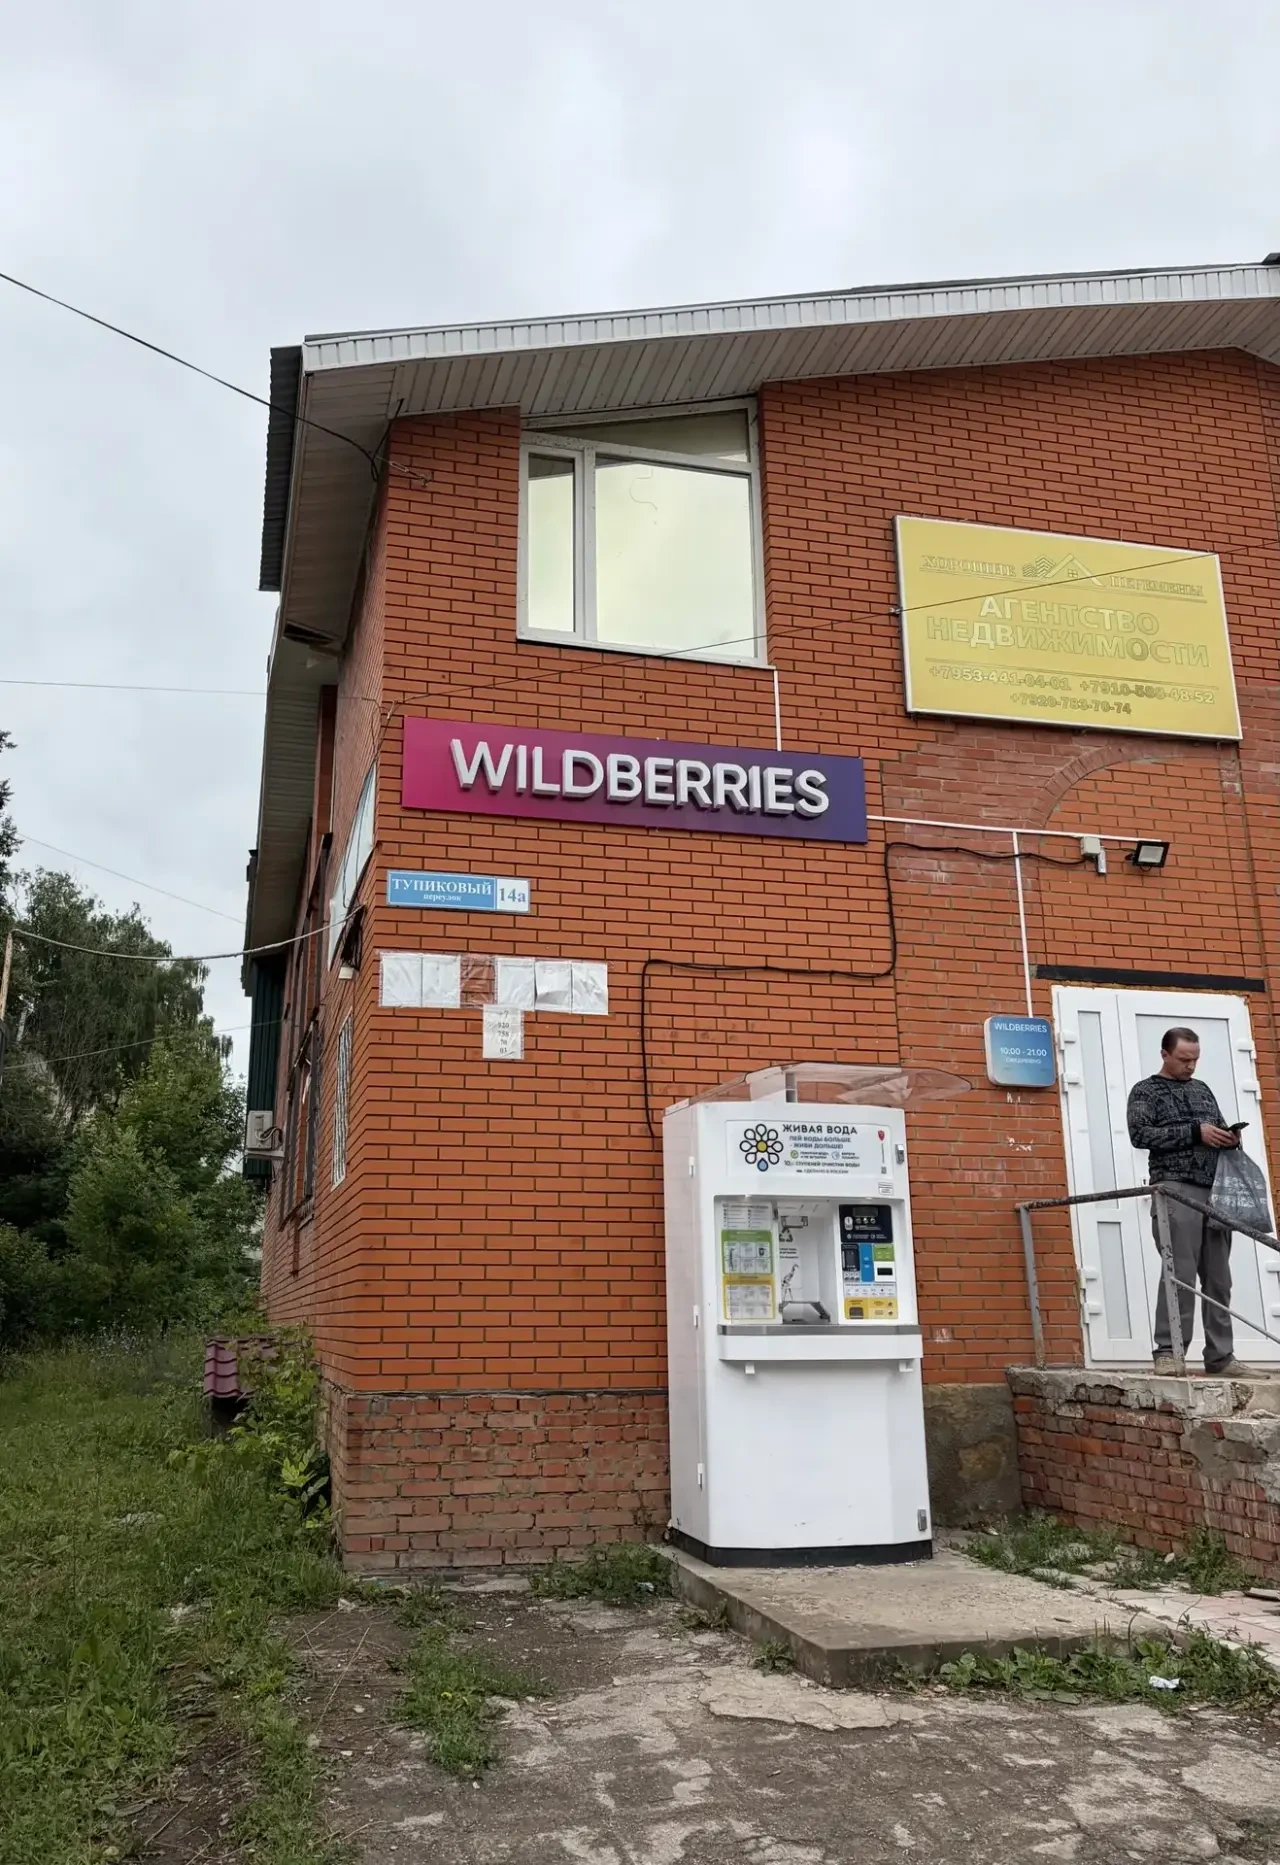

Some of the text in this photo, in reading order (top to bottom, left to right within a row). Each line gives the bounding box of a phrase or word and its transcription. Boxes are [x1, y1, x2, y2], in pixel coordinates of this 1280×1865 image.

[980, 595, 1159, 636] АГЕНТСТВО
[926, 616, 1210, 667] НЕДВИЖИМОСТИ
[450, 738, 829, 817] WILDBERRIES
[391, 878, 492, 895] ТУПИКОВЫЙ
[423, 893, 462, 902] переулок
[499, 888, 526, 903] 14а
[994, 1022, 1048, 1033] WILDBERRIES
[1000, 1047, 1021, 1055] 10:00
[782, 1124, 858, 1136] ЖИВАЯ ВОДА
